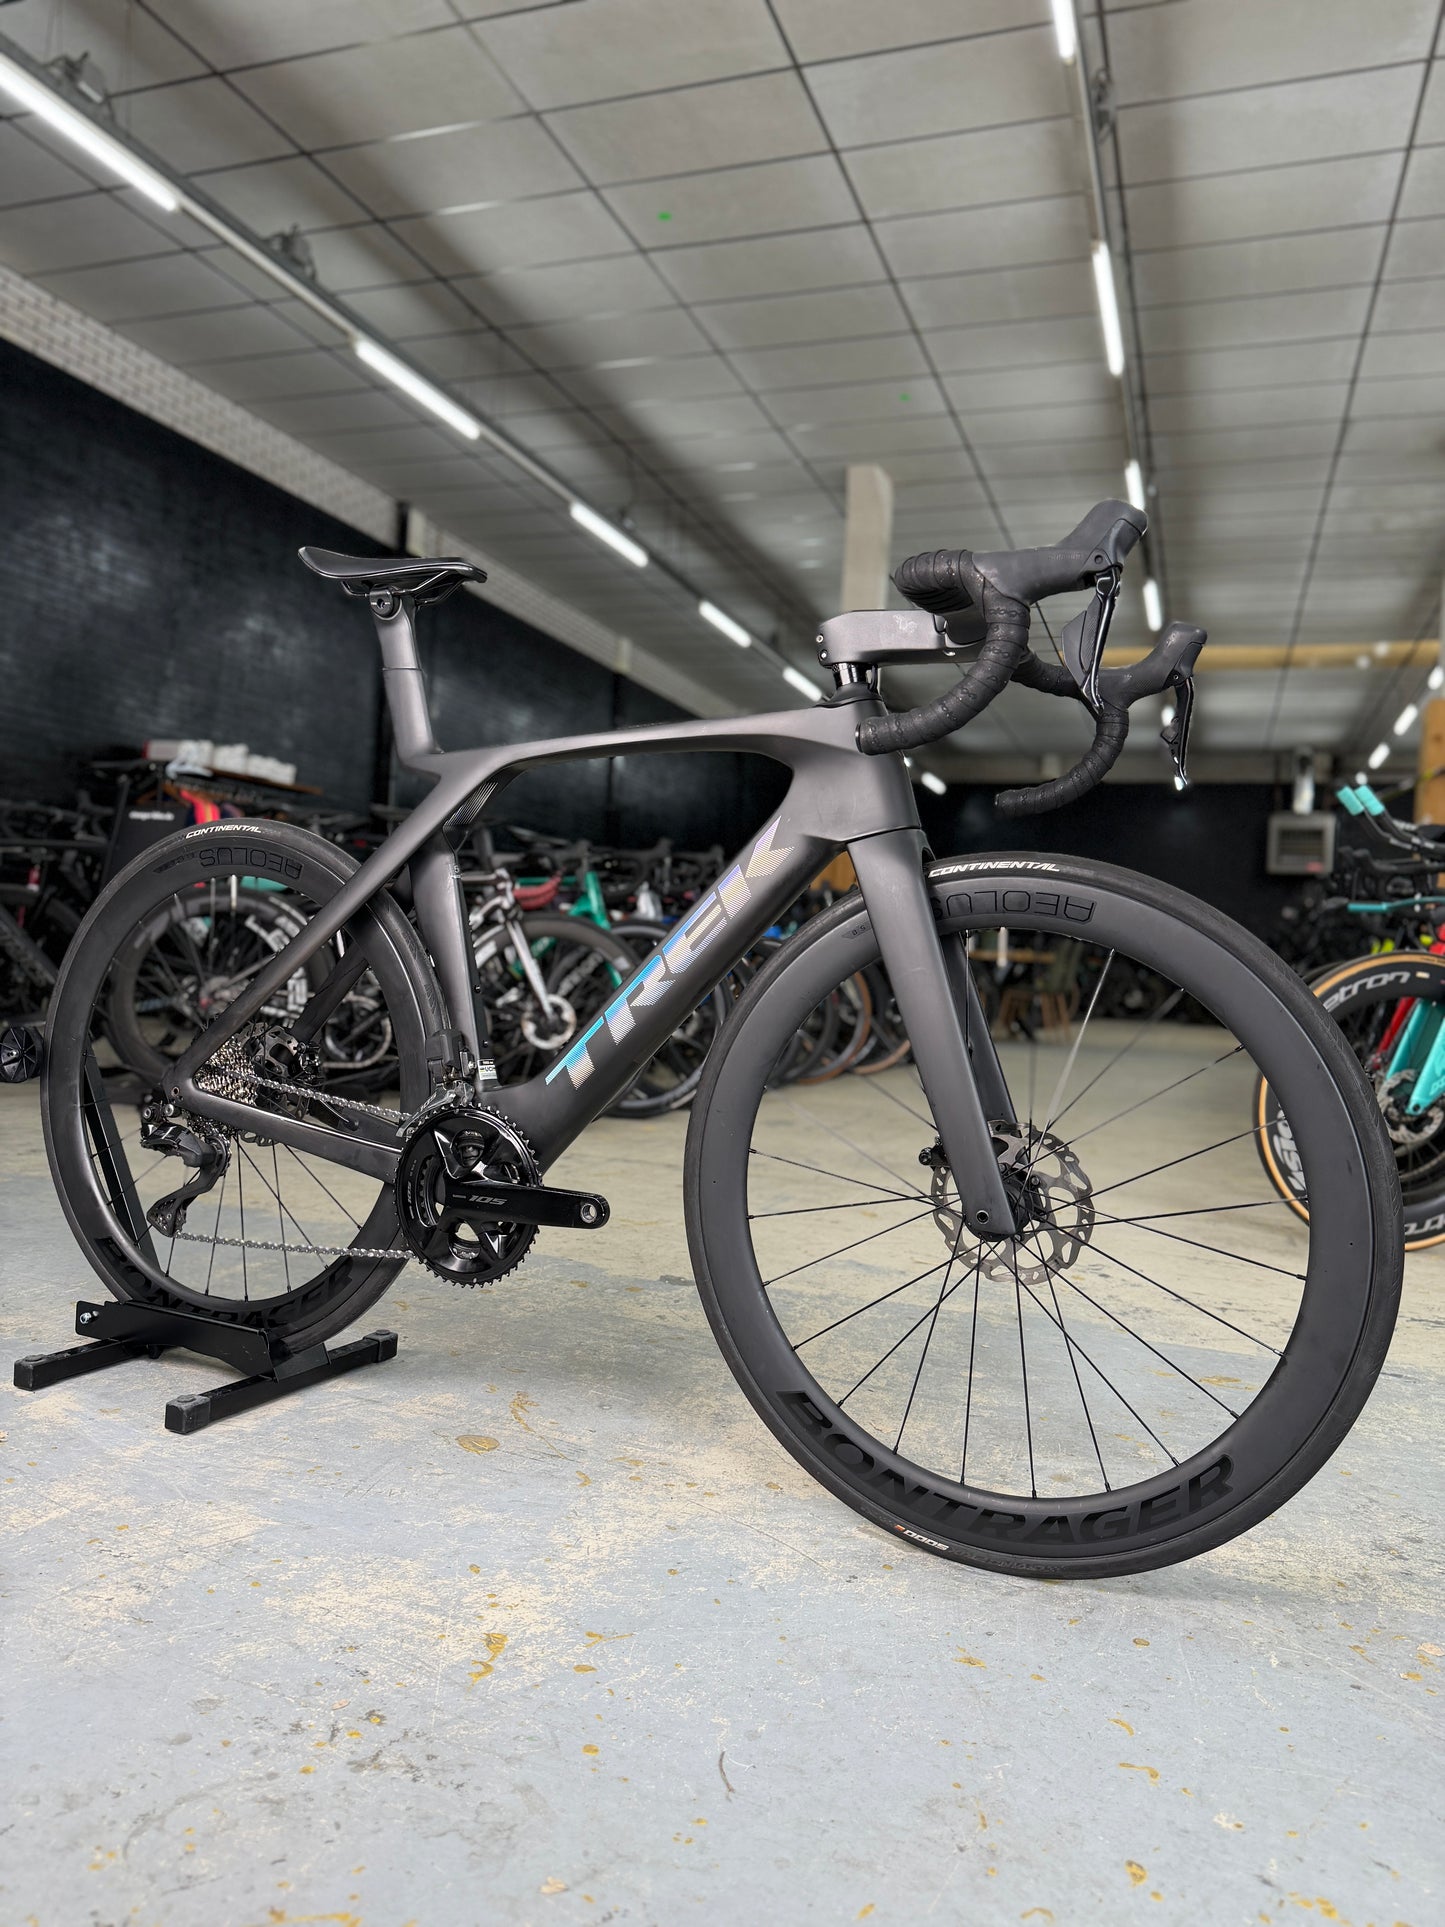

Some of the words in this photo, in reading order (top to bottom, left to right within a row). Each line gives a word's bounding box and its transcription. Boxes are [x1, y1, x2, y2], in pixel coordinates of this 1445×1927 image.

[185, 824, 262, 840] CONTINENTAL
[199, 848, 303, 879] AEOLUS
[928, 862, 1060, 878] CONTINENTAL
[930, 891, 1096, 924] AEOLUS
[545, 816, 795, 1090] TREK
[468, 1194, 508, 1206] 105
[777, 1390, 1234, 1545] BONTRAGER
